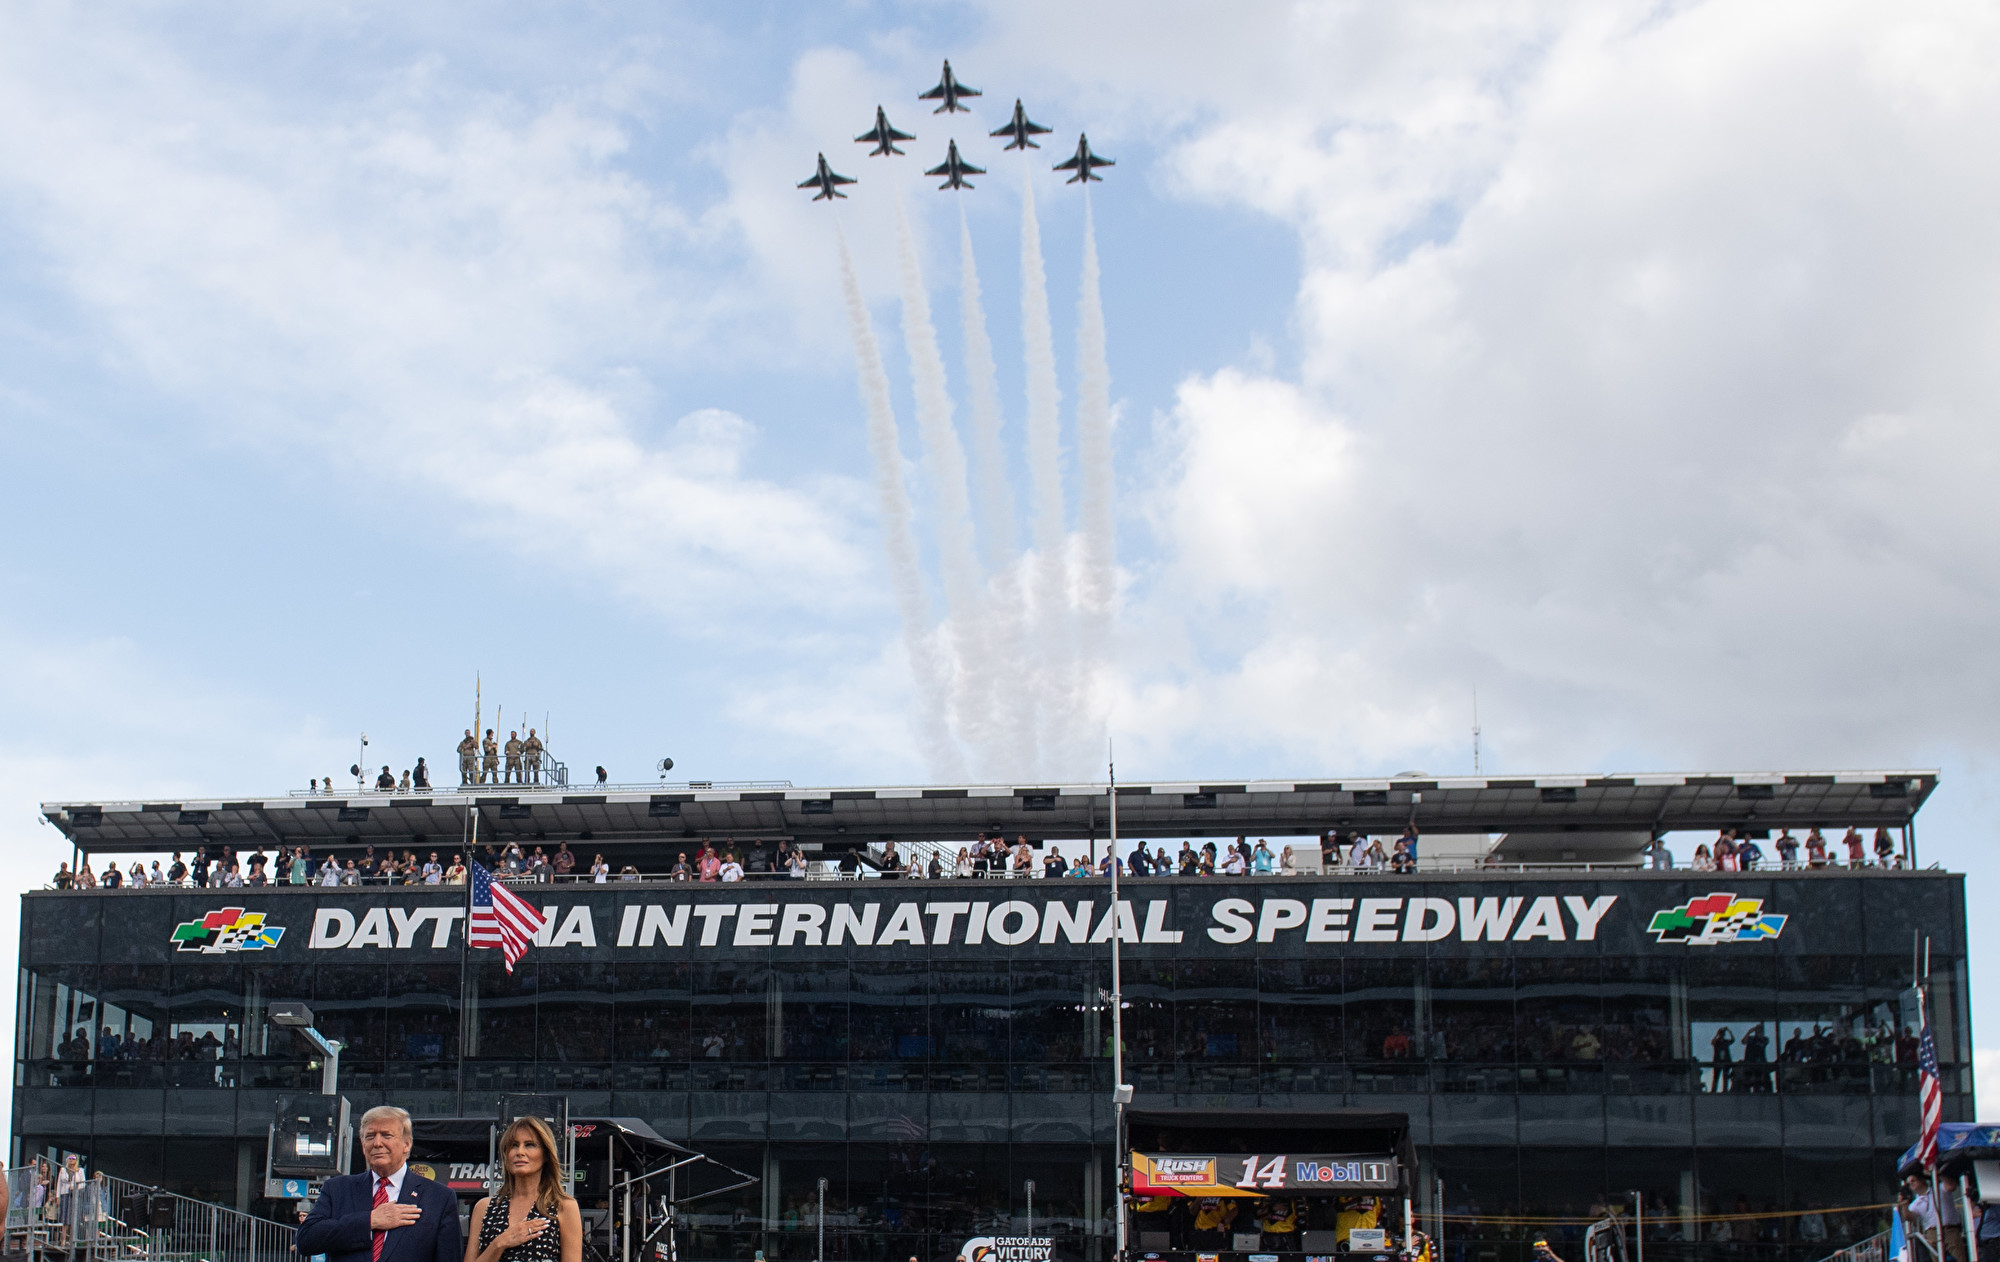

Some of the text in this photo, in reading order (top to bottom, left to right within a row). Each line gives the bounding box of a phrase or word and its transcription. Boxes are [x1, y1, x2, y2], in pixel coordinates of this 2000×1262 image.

[308, 893, 1618, 949] DAYTNA INTERNATIONAL SPEEDWAY
[1235, 1155, 1287, 1188] 14
[1296, 1161, 1361, 1182] Mobil
[996, 1237, 1052, 1246] GATORADE
[996, 1246, 1052, 1260] VICTORY
